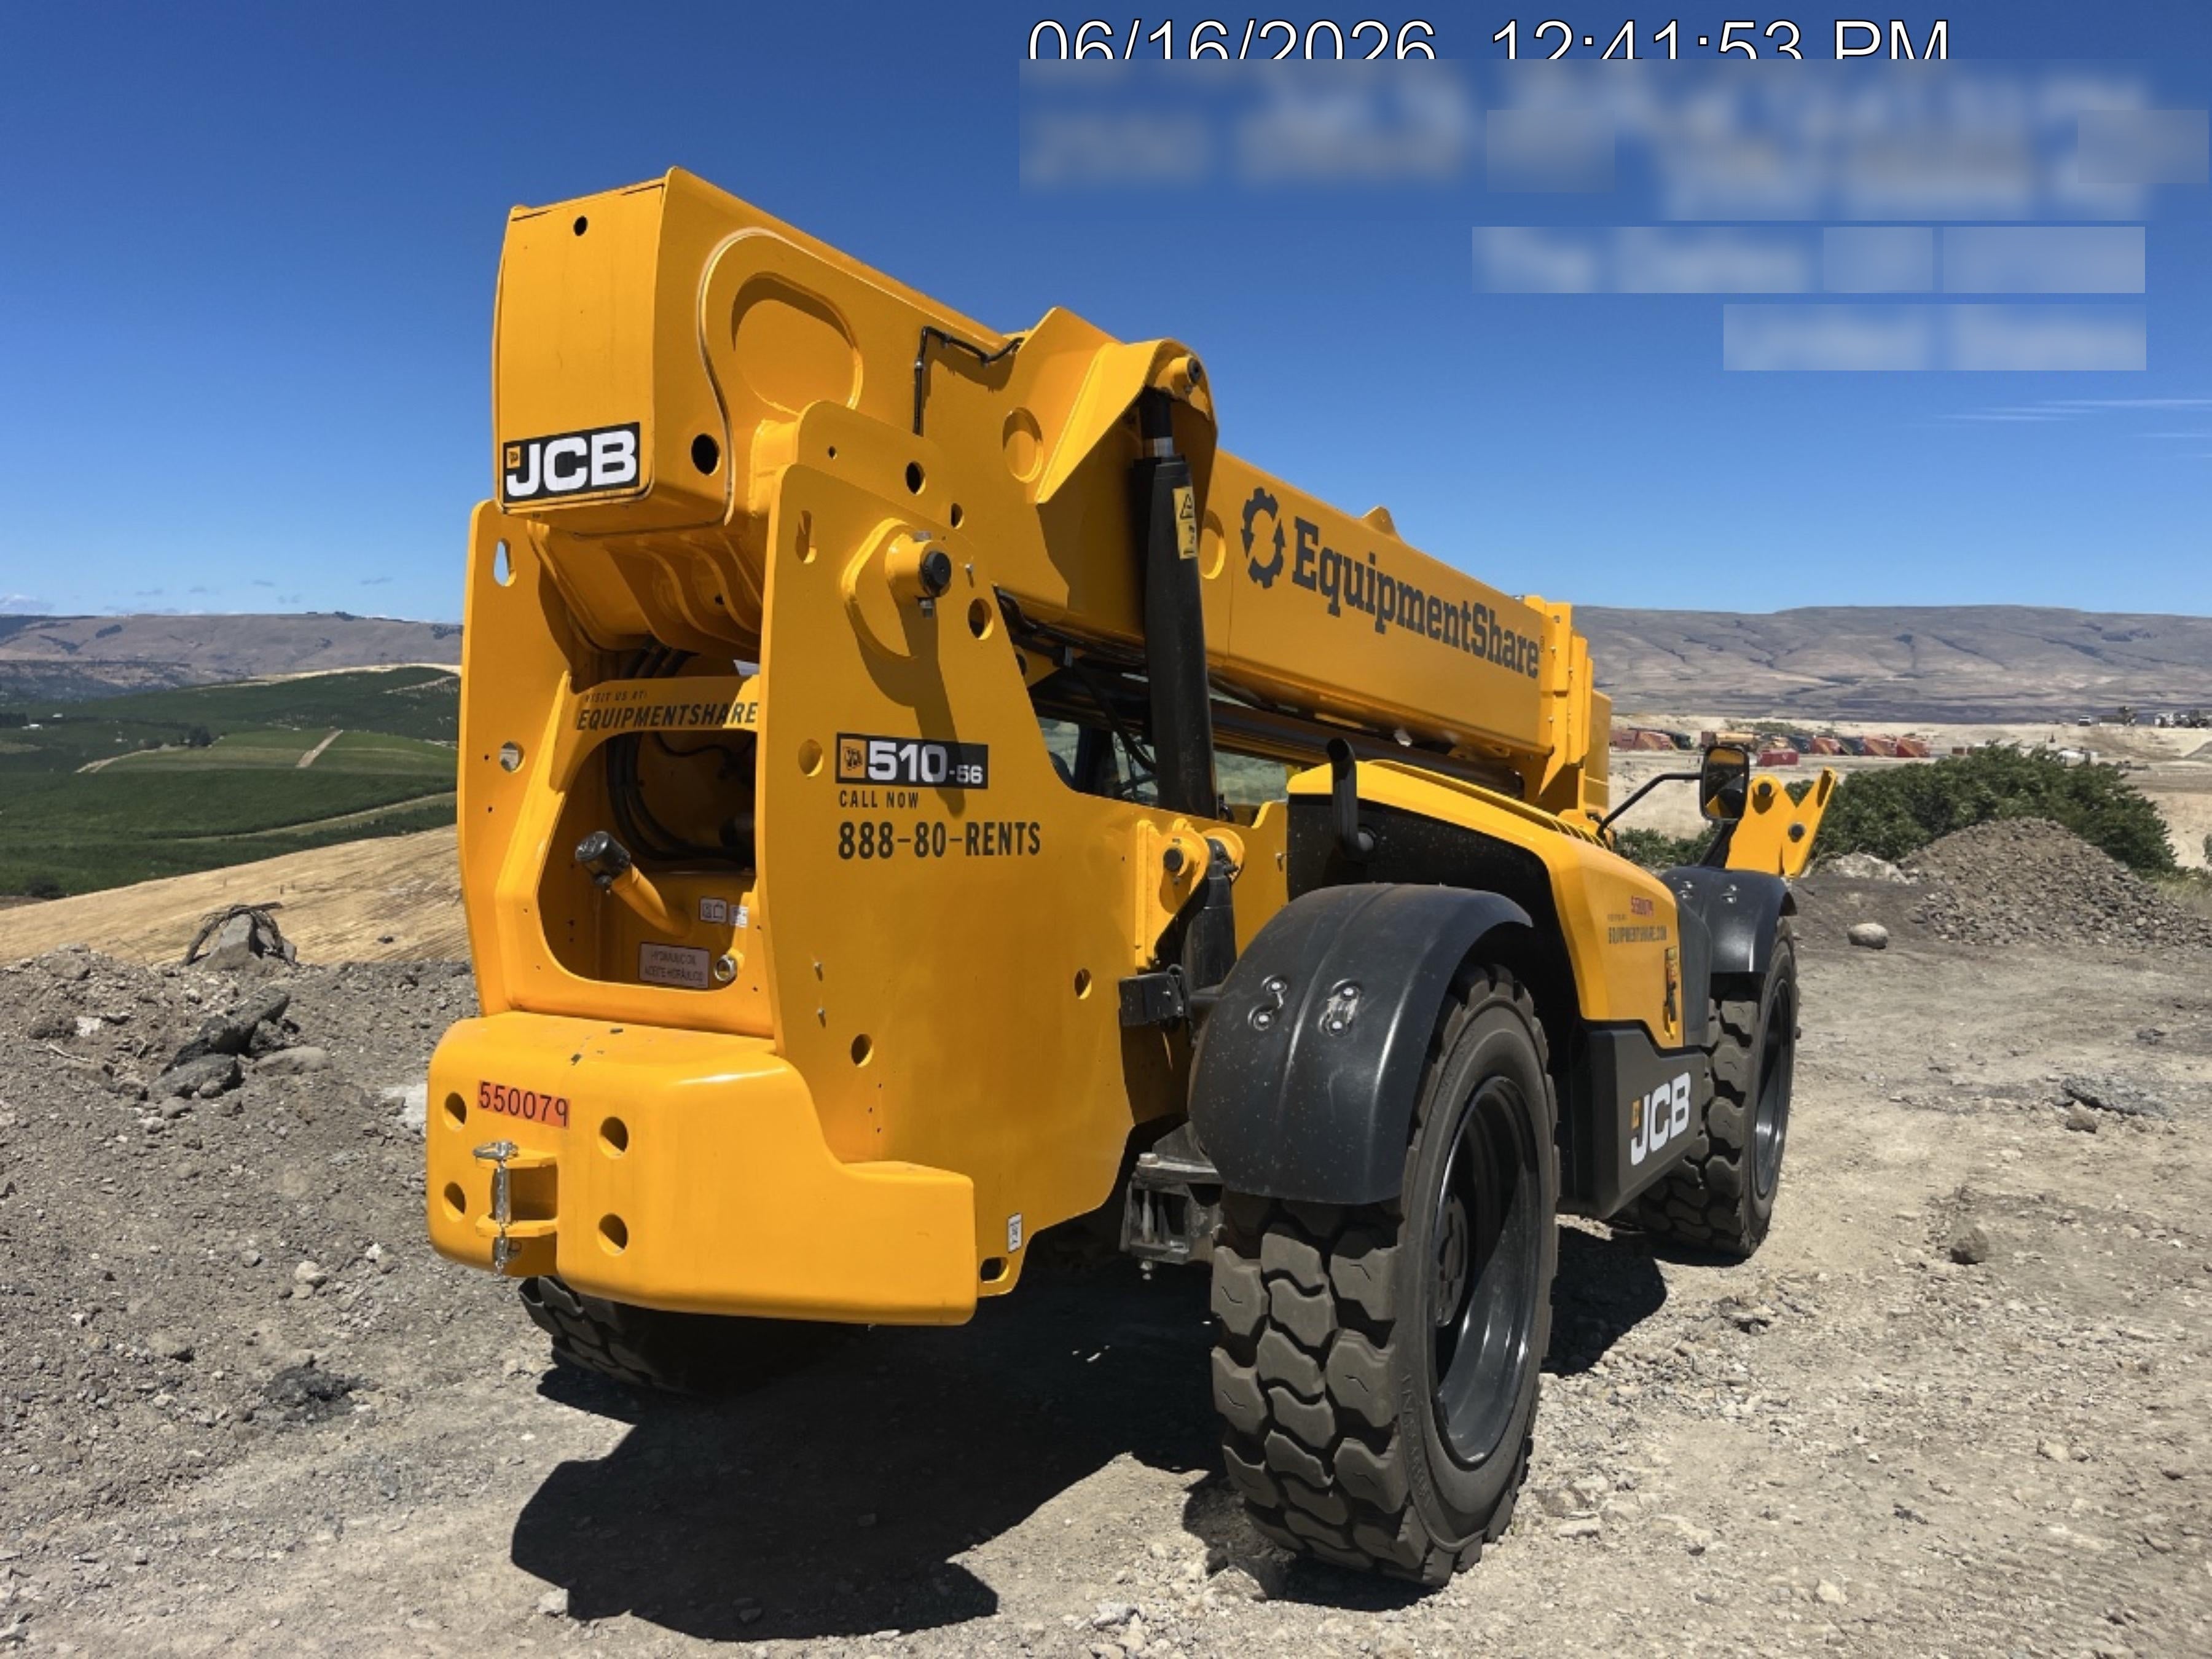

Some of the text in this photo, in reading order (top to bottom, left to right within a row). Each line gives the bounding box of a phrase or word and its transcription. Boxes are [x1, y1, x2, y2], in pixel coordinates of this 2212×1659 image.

[506, 429, 637, 497] JCB
[1292, 515, 1539, 680] EquipmentShare
[614, 690, 627, 701] US
[867, 740, 983, 785] 510-56
[839, 790, 919, 809] CALL NOW
[838, 821, 1041, 860] 888-80-RENTS
[479, 1080, 569, 1127] 550079
[1631, 1071, 1692, 1166] JCB
